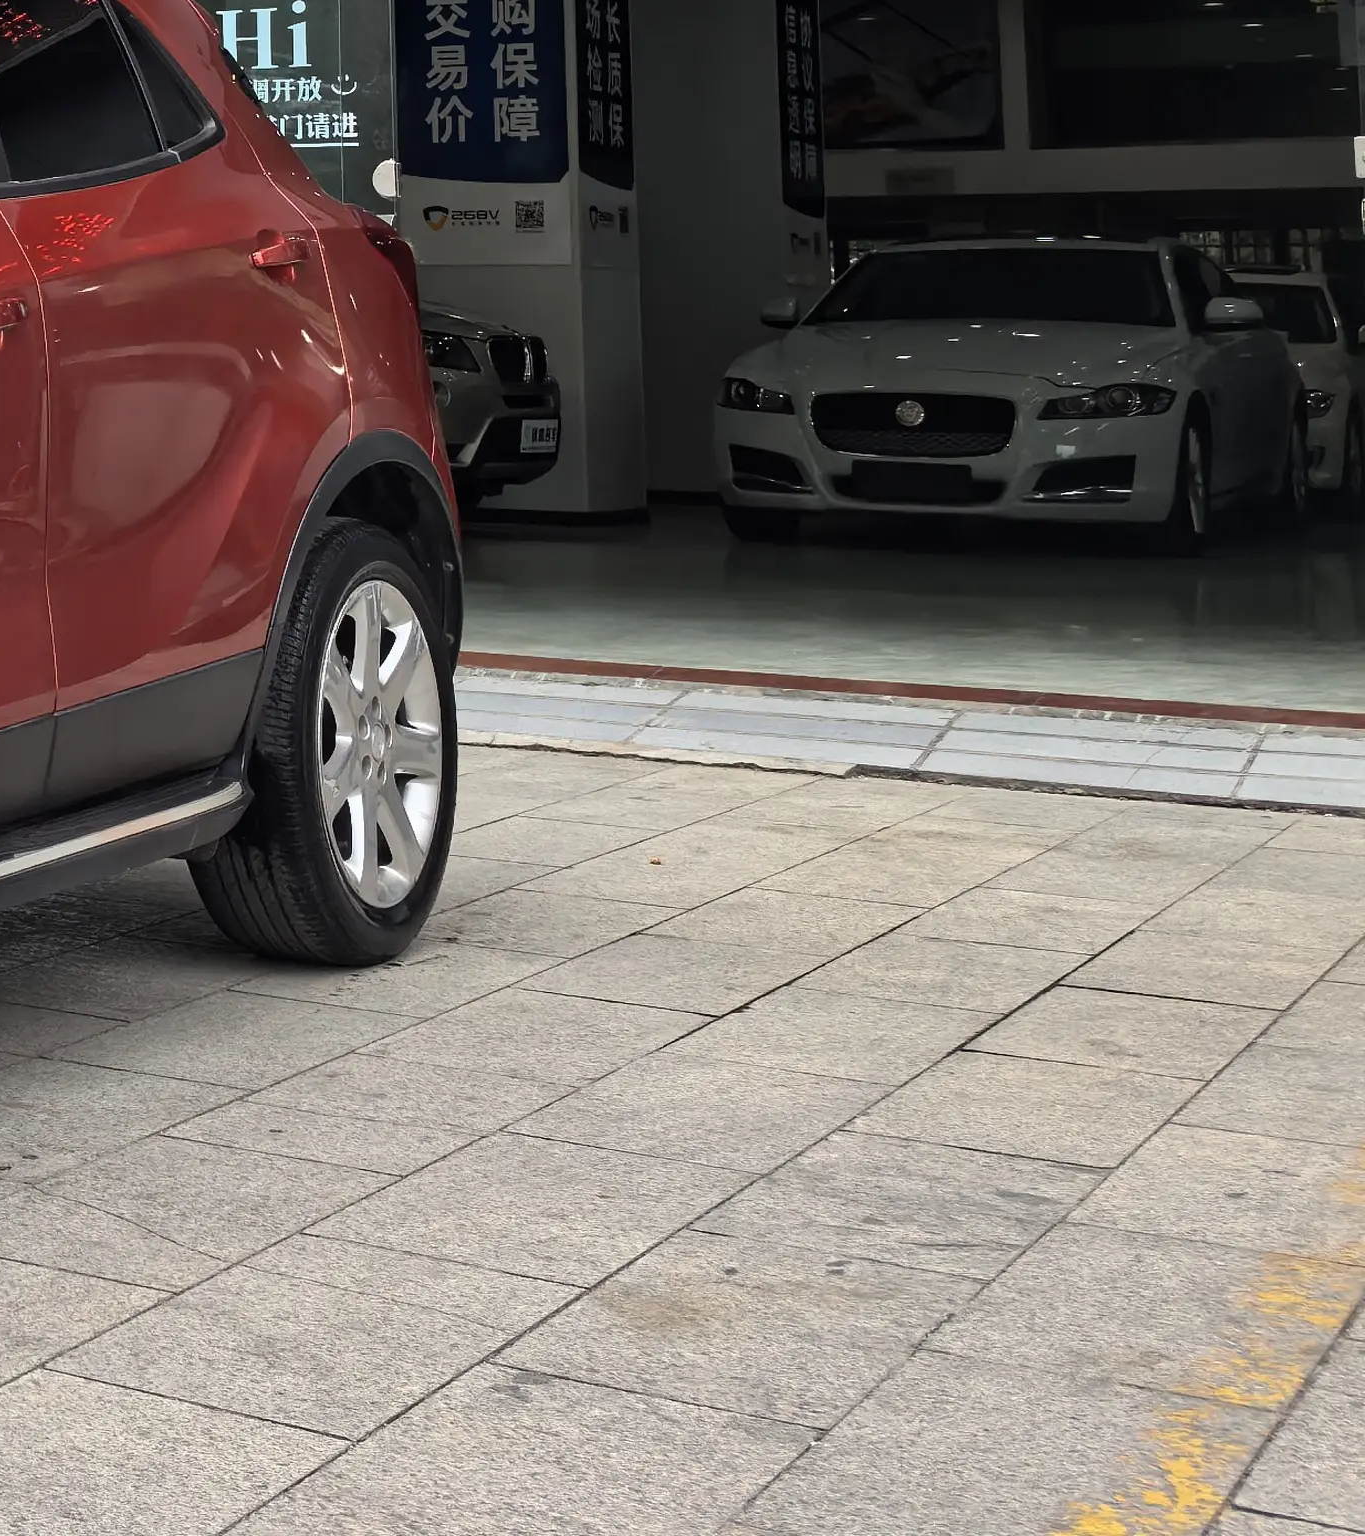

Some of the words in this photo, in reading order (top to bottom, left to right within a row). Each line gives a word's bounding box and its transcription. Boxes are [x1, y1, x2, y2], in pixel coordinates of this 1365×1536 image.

[216, 0, 312, 70] Hi
[267, 112, 359, 140] 门请进
